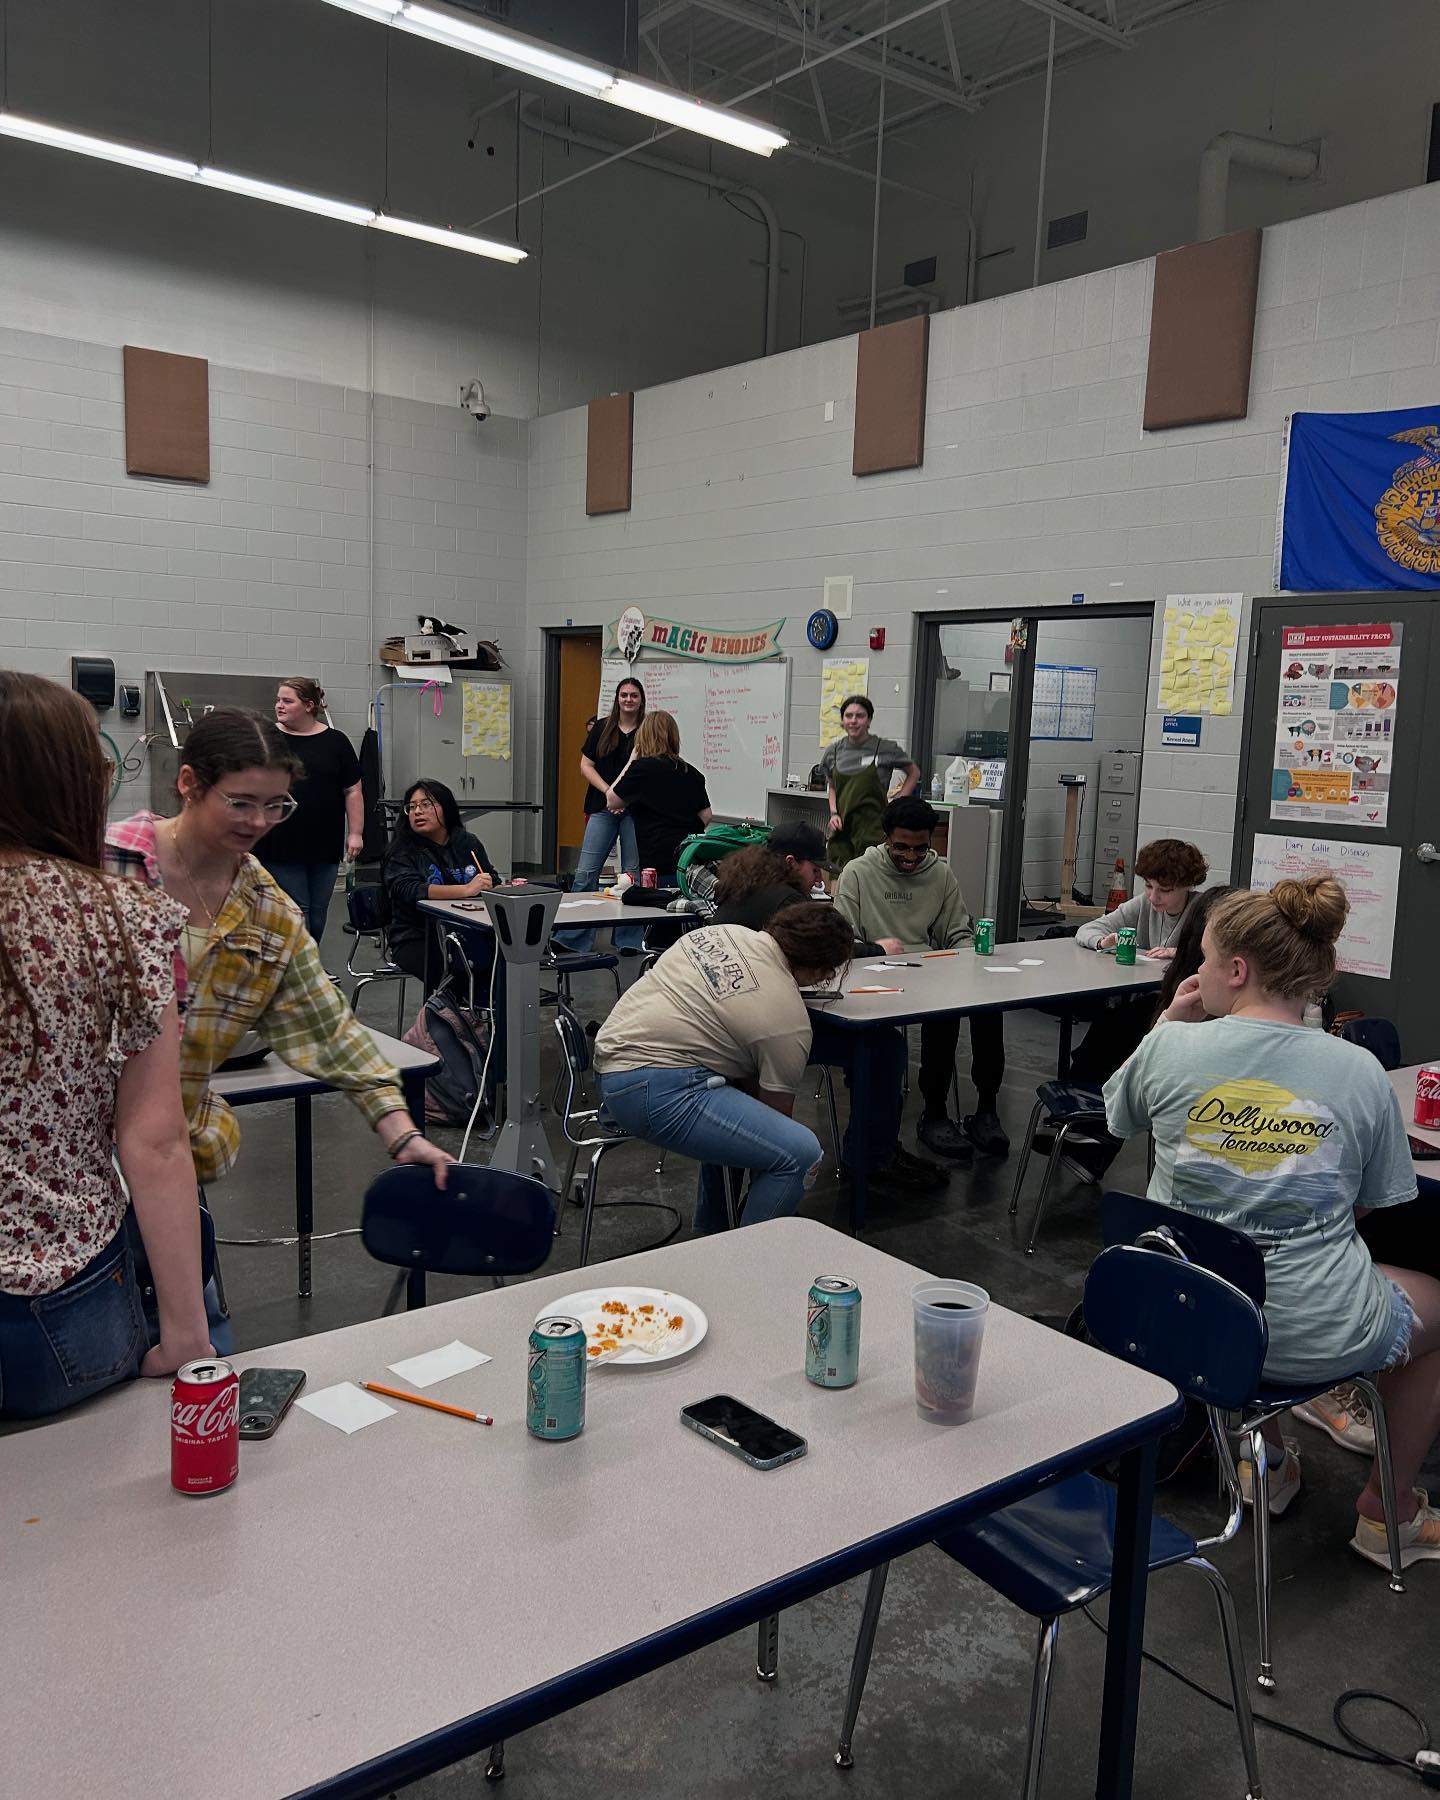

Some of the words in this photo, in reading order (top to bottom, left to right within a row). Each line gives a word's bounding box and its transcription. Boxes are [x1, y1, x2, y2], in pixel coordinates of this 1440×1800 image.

[711, 633, 767, 655] MEMORIES
[1322, 634, 1370, 642] SUSTAINABILITY
[1340, 845, 1370, 858] Diseases
[1187, 1098, 1334, 1139] Dollywood
[1220, 1129, 1309, 1155] Tennessee
[176, 1435, 205, 1445] ORIGINAL
[208, 1433, 228, 1443] TASTE
